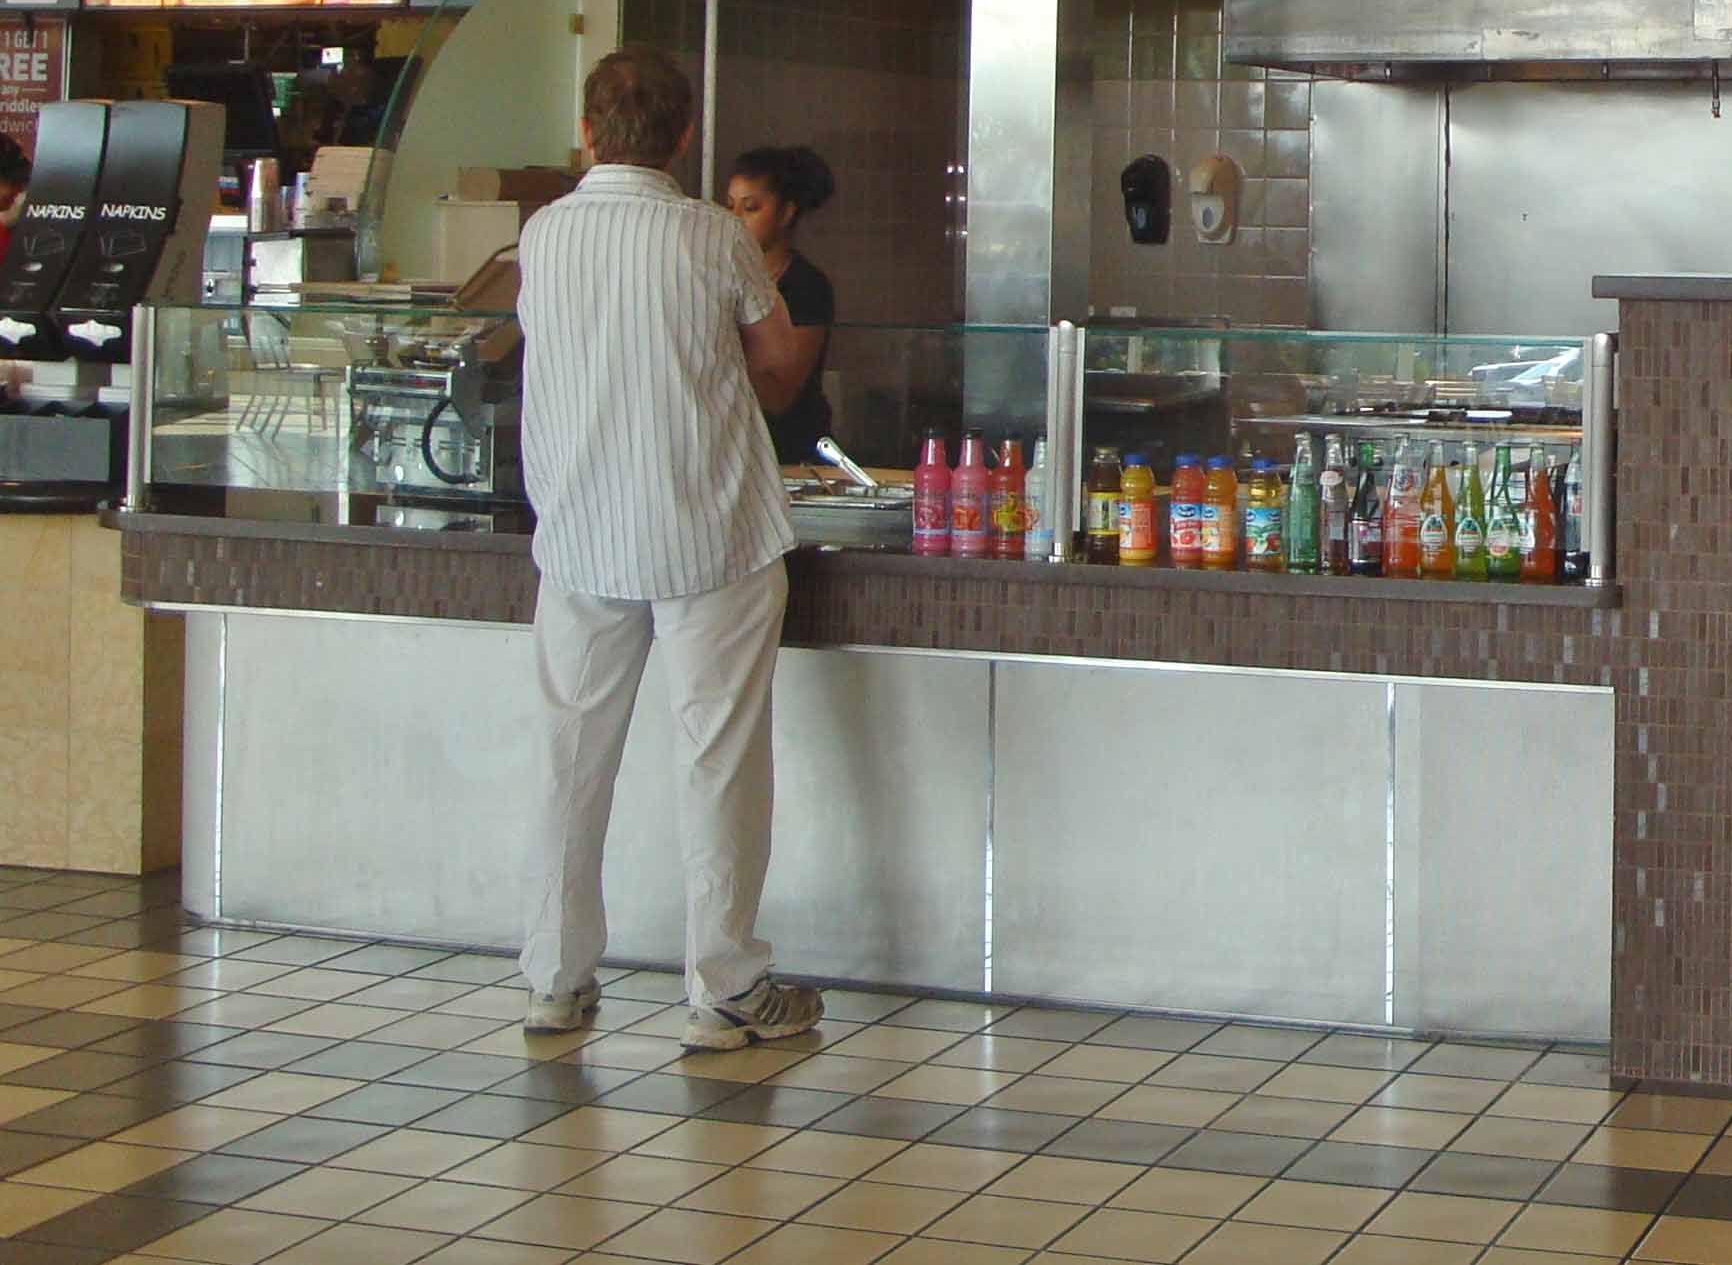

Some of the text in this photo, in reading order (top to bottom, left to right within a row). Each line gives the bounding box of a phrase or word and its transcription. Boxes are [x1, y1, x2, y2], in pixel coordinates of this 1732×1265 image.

[0, 52, 49, 81] REE
[26, 203, 87, 220] NAPKINS
[101, 203, 167, 221] NAPKINS
